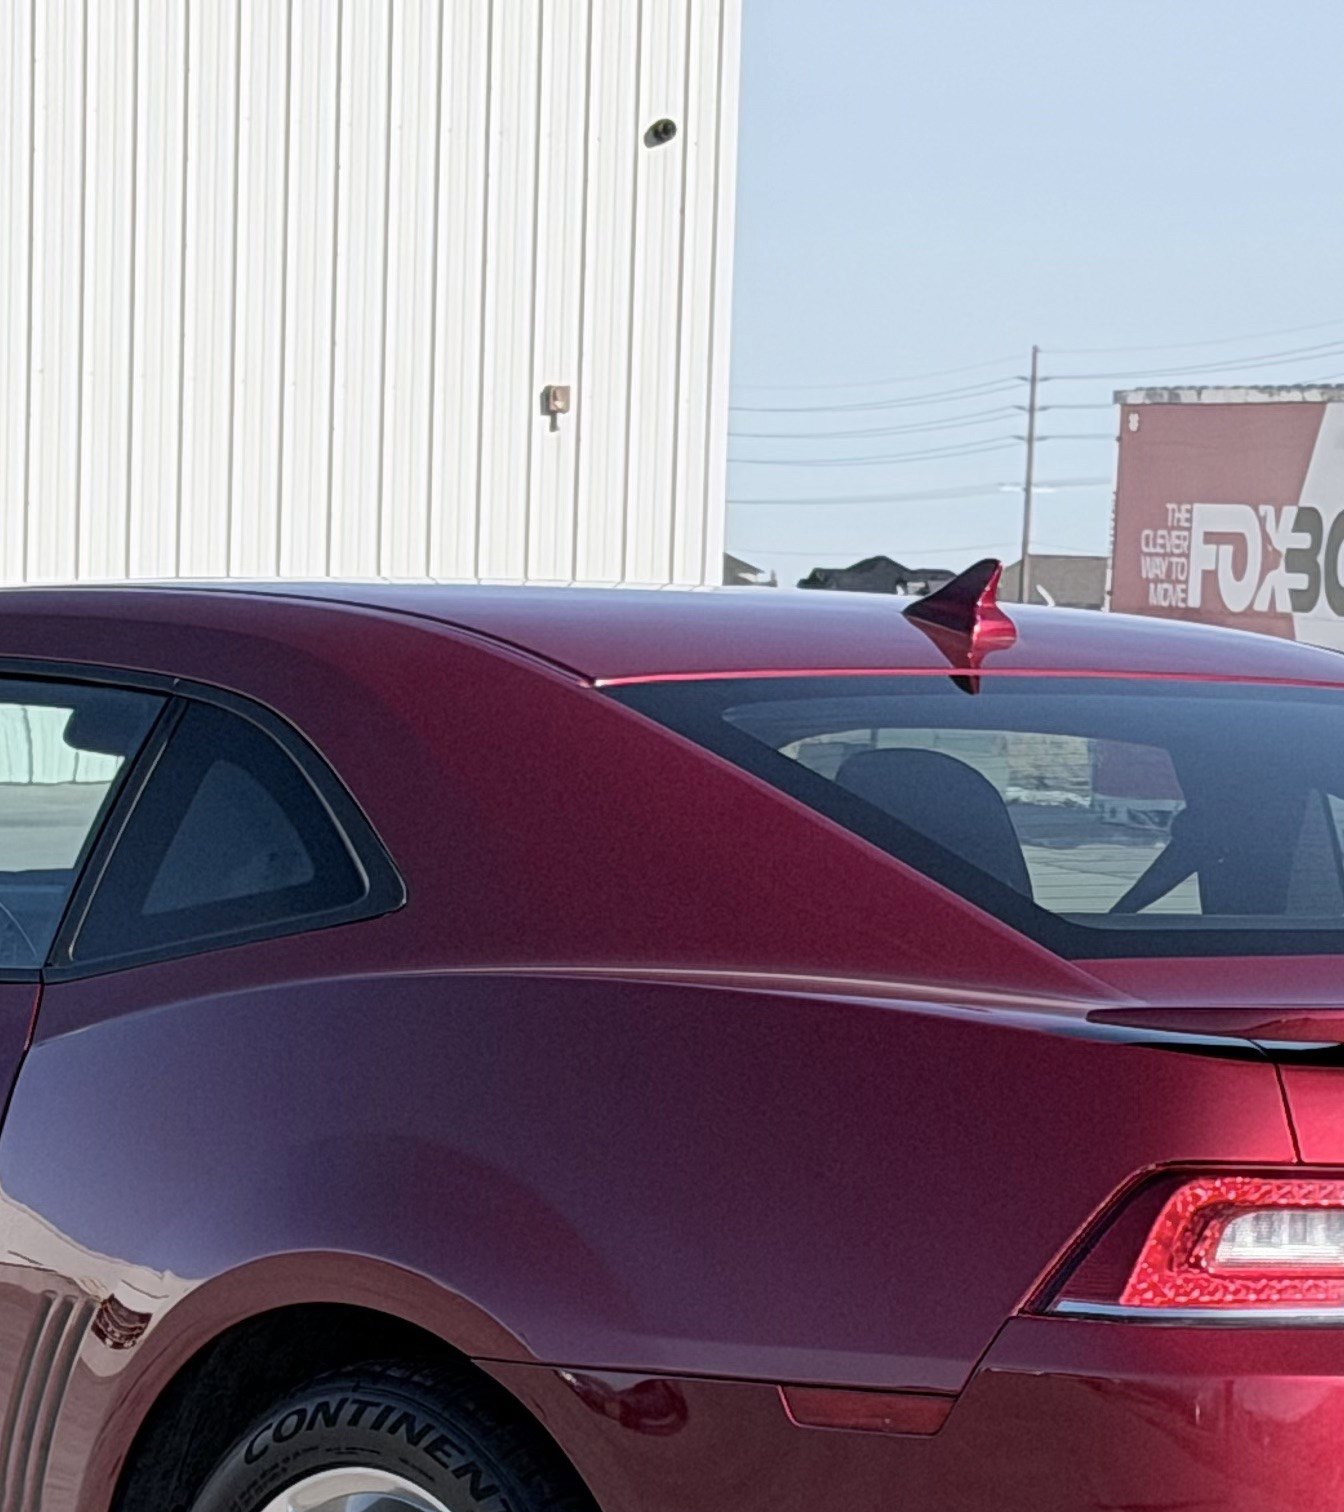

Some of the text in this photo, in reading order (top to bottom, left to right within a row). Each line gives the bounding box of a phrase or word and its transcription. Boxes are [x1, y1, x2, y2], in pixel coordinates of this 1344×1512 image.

[1165, 502, 1191, 527] THE
[1140, 529, 1189, 554] CLEVER
[1140, 556, 1188, 582] WAY TO
[1149, 582, 1188, 608] MOVE
